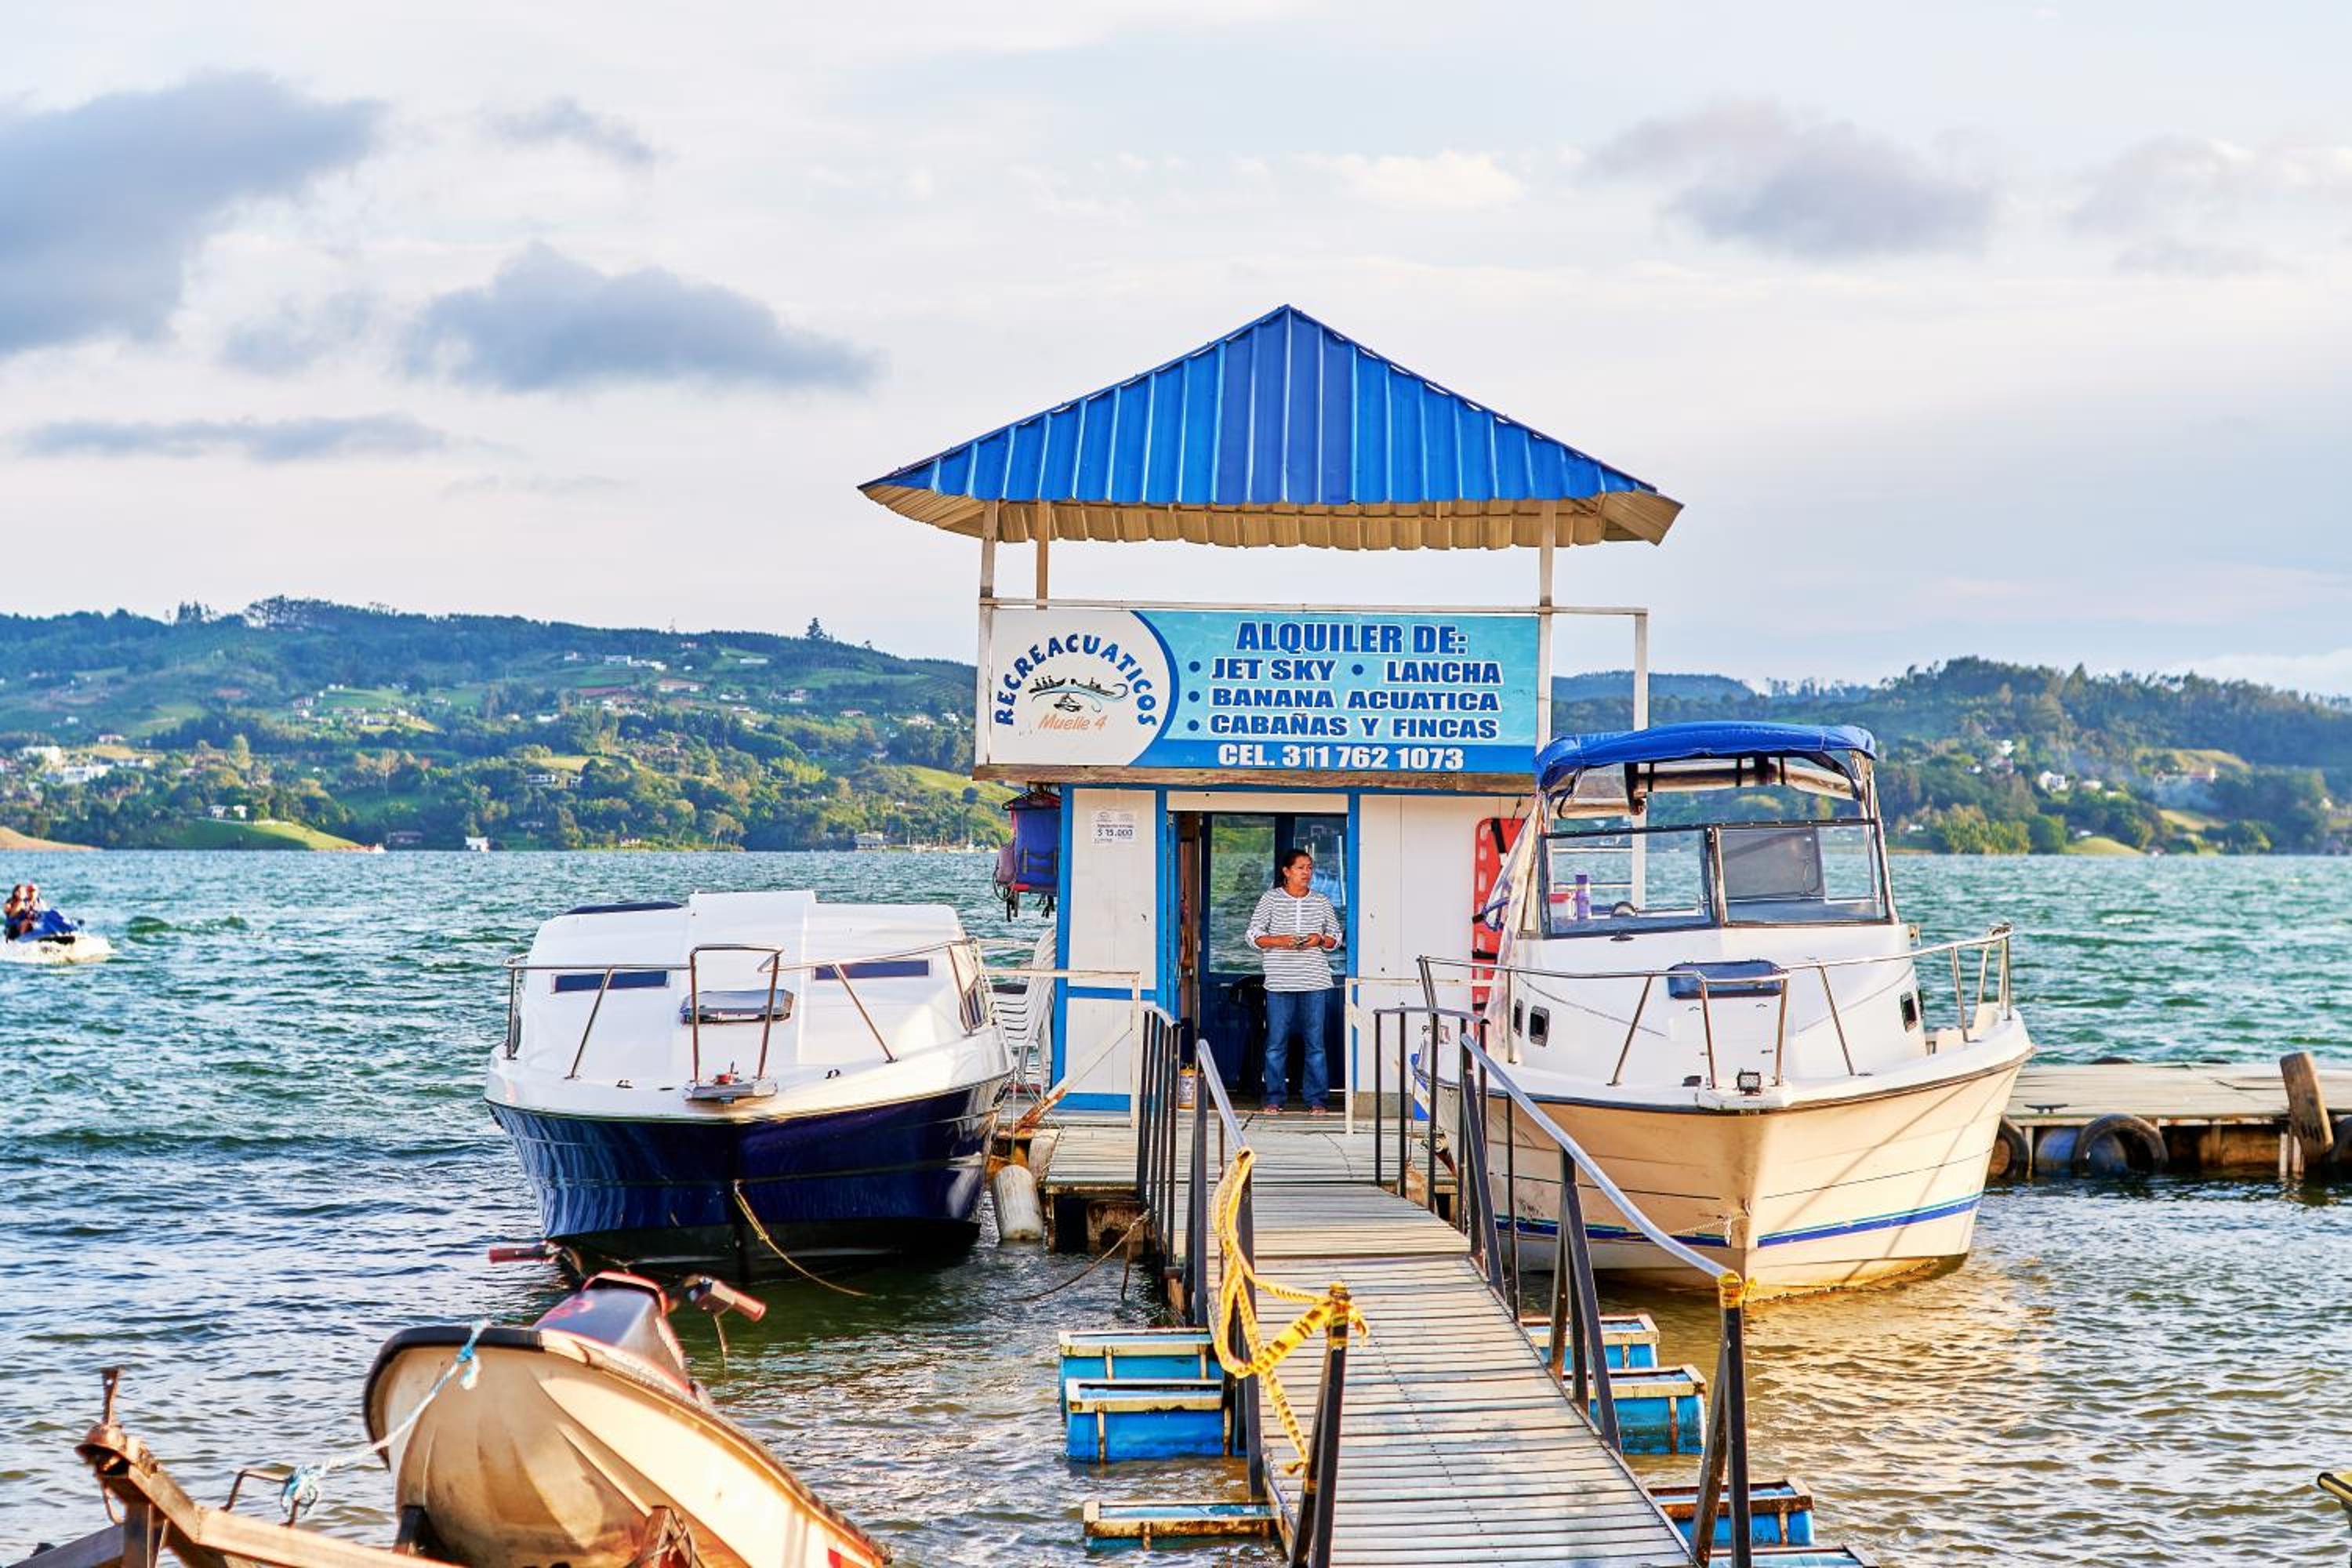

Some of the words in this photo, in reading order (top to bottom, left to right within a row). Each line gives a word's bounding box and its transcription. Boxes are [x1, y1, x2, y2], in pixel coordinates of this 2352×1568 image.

[1236, 622, 1403, 654] ALQUILER
[1414, 626, 1467, 655] DE:
[995, 633, 1157, 726] RECREACUATICOS
[1212, 659, 1262, 679] JET
[1271, 659, 1336, 681] SKY
[1386, 662, 1501, 684] LANCHA
[1214, 688, 1334, 708] BANANA
[1348, 691, 1499, 711] ACUATICA
[1038, 713, 1090, 731] Muelle
[1094, 715, 1108, 731] 4
[1210, 713, 1347, 736] CABAÑAS
[1361, 717, 1378, 736] Y
[1393, 718, 1497, 739] FINCAS
[1218, 744, 1276, 766] CEL.
[1283, 746, 1329, 768] 311
[1338, 746, 1388, 768] 762
[1396, 747, 1464, 769] 1073
